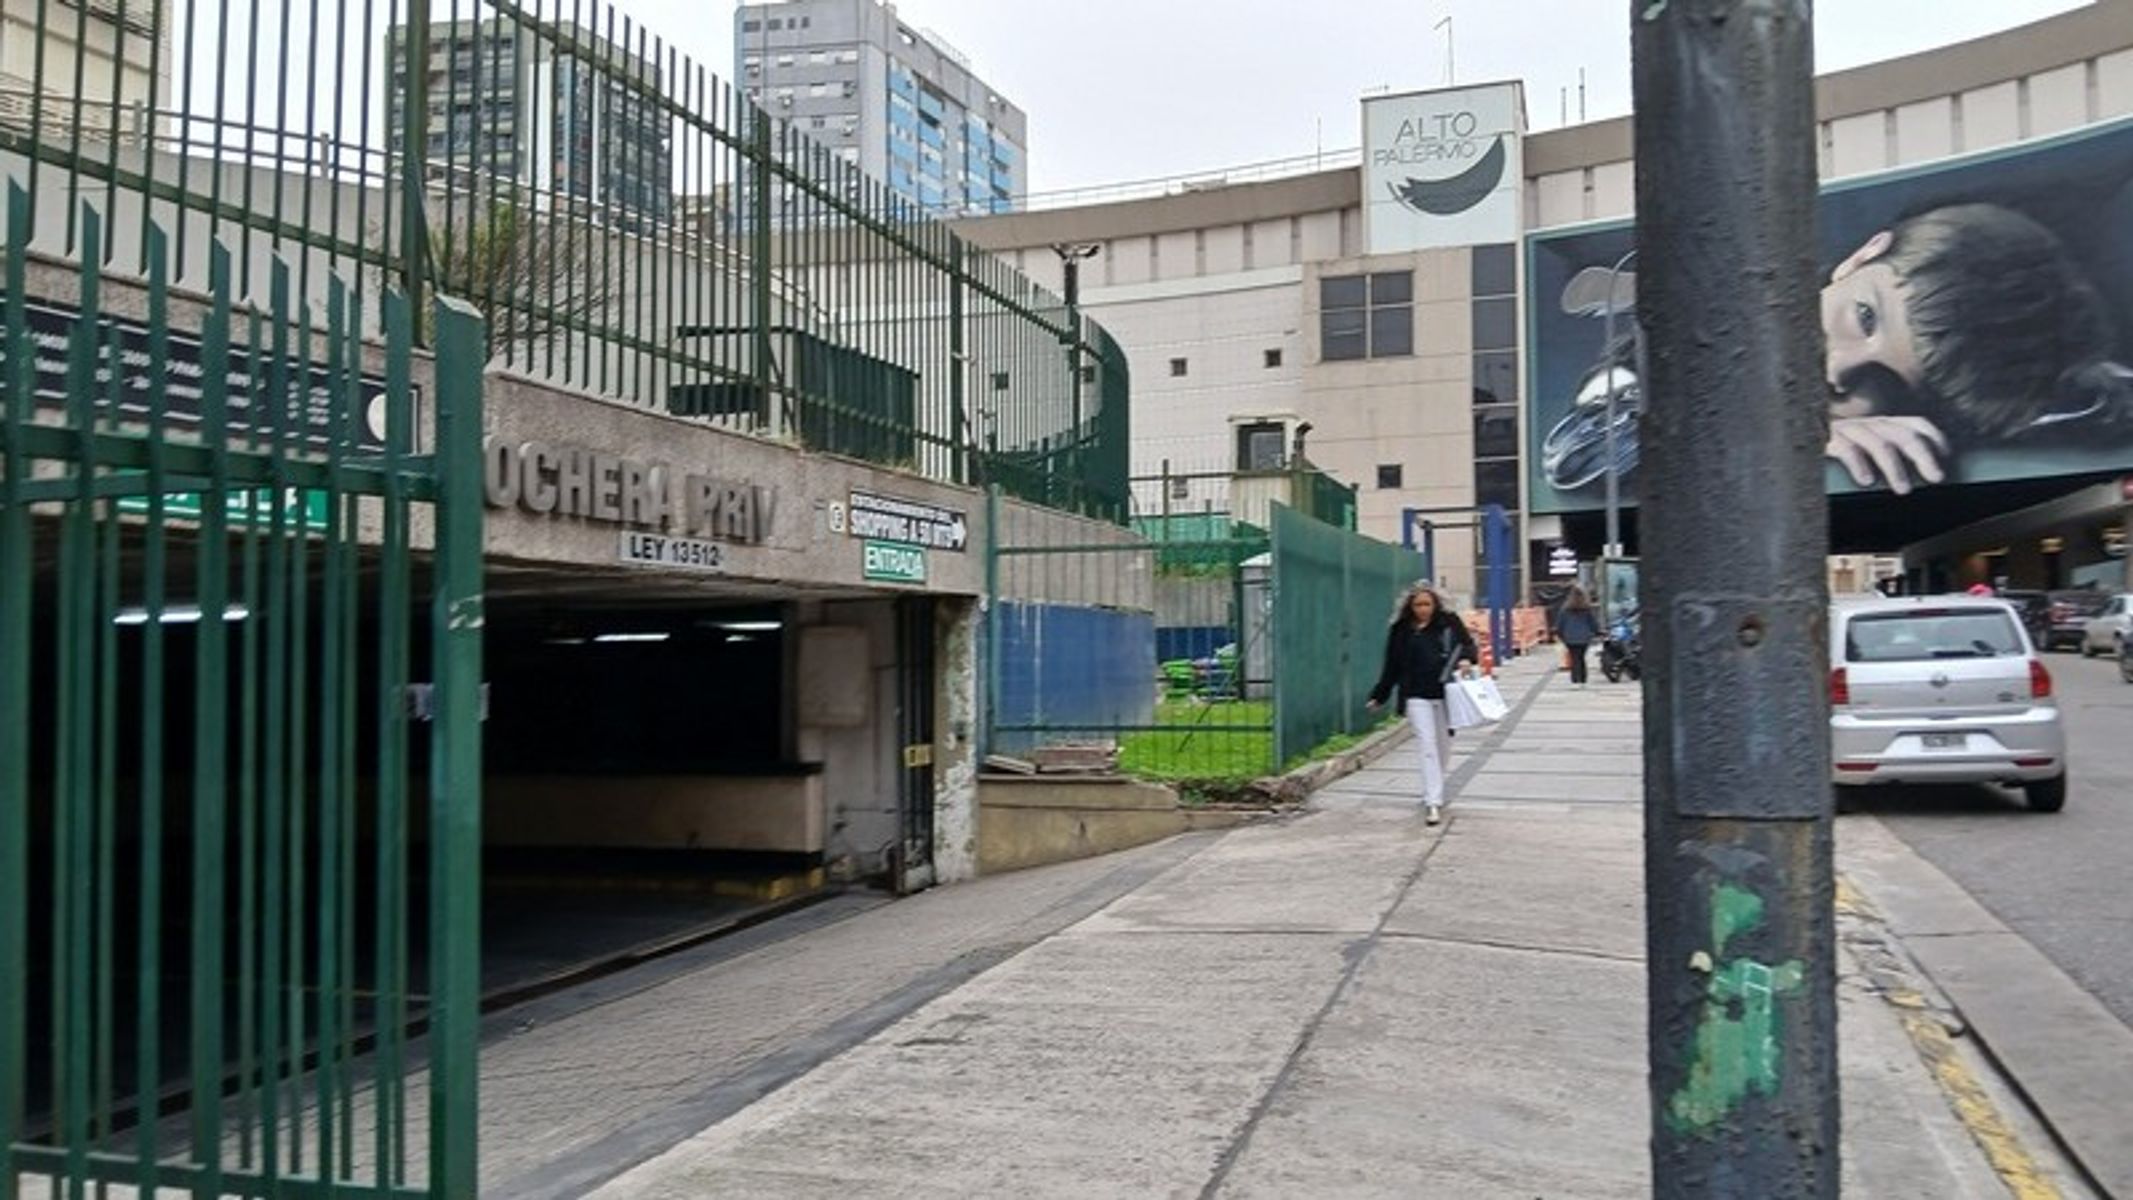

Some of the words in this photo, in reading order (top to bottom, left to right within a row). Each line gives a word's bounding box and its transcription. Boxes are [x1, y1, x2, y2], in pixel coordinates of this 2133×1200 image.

[1394, 111, 1476, 144] ALTO
[1373, 140, 1477, 166] PALERMO
[684, 474, 778, 544] PRIV
[630, 535, 666, 561] LEY
[672, 541, 719, 567] 13512
[866, 546, 925, 576] ENTRADA
